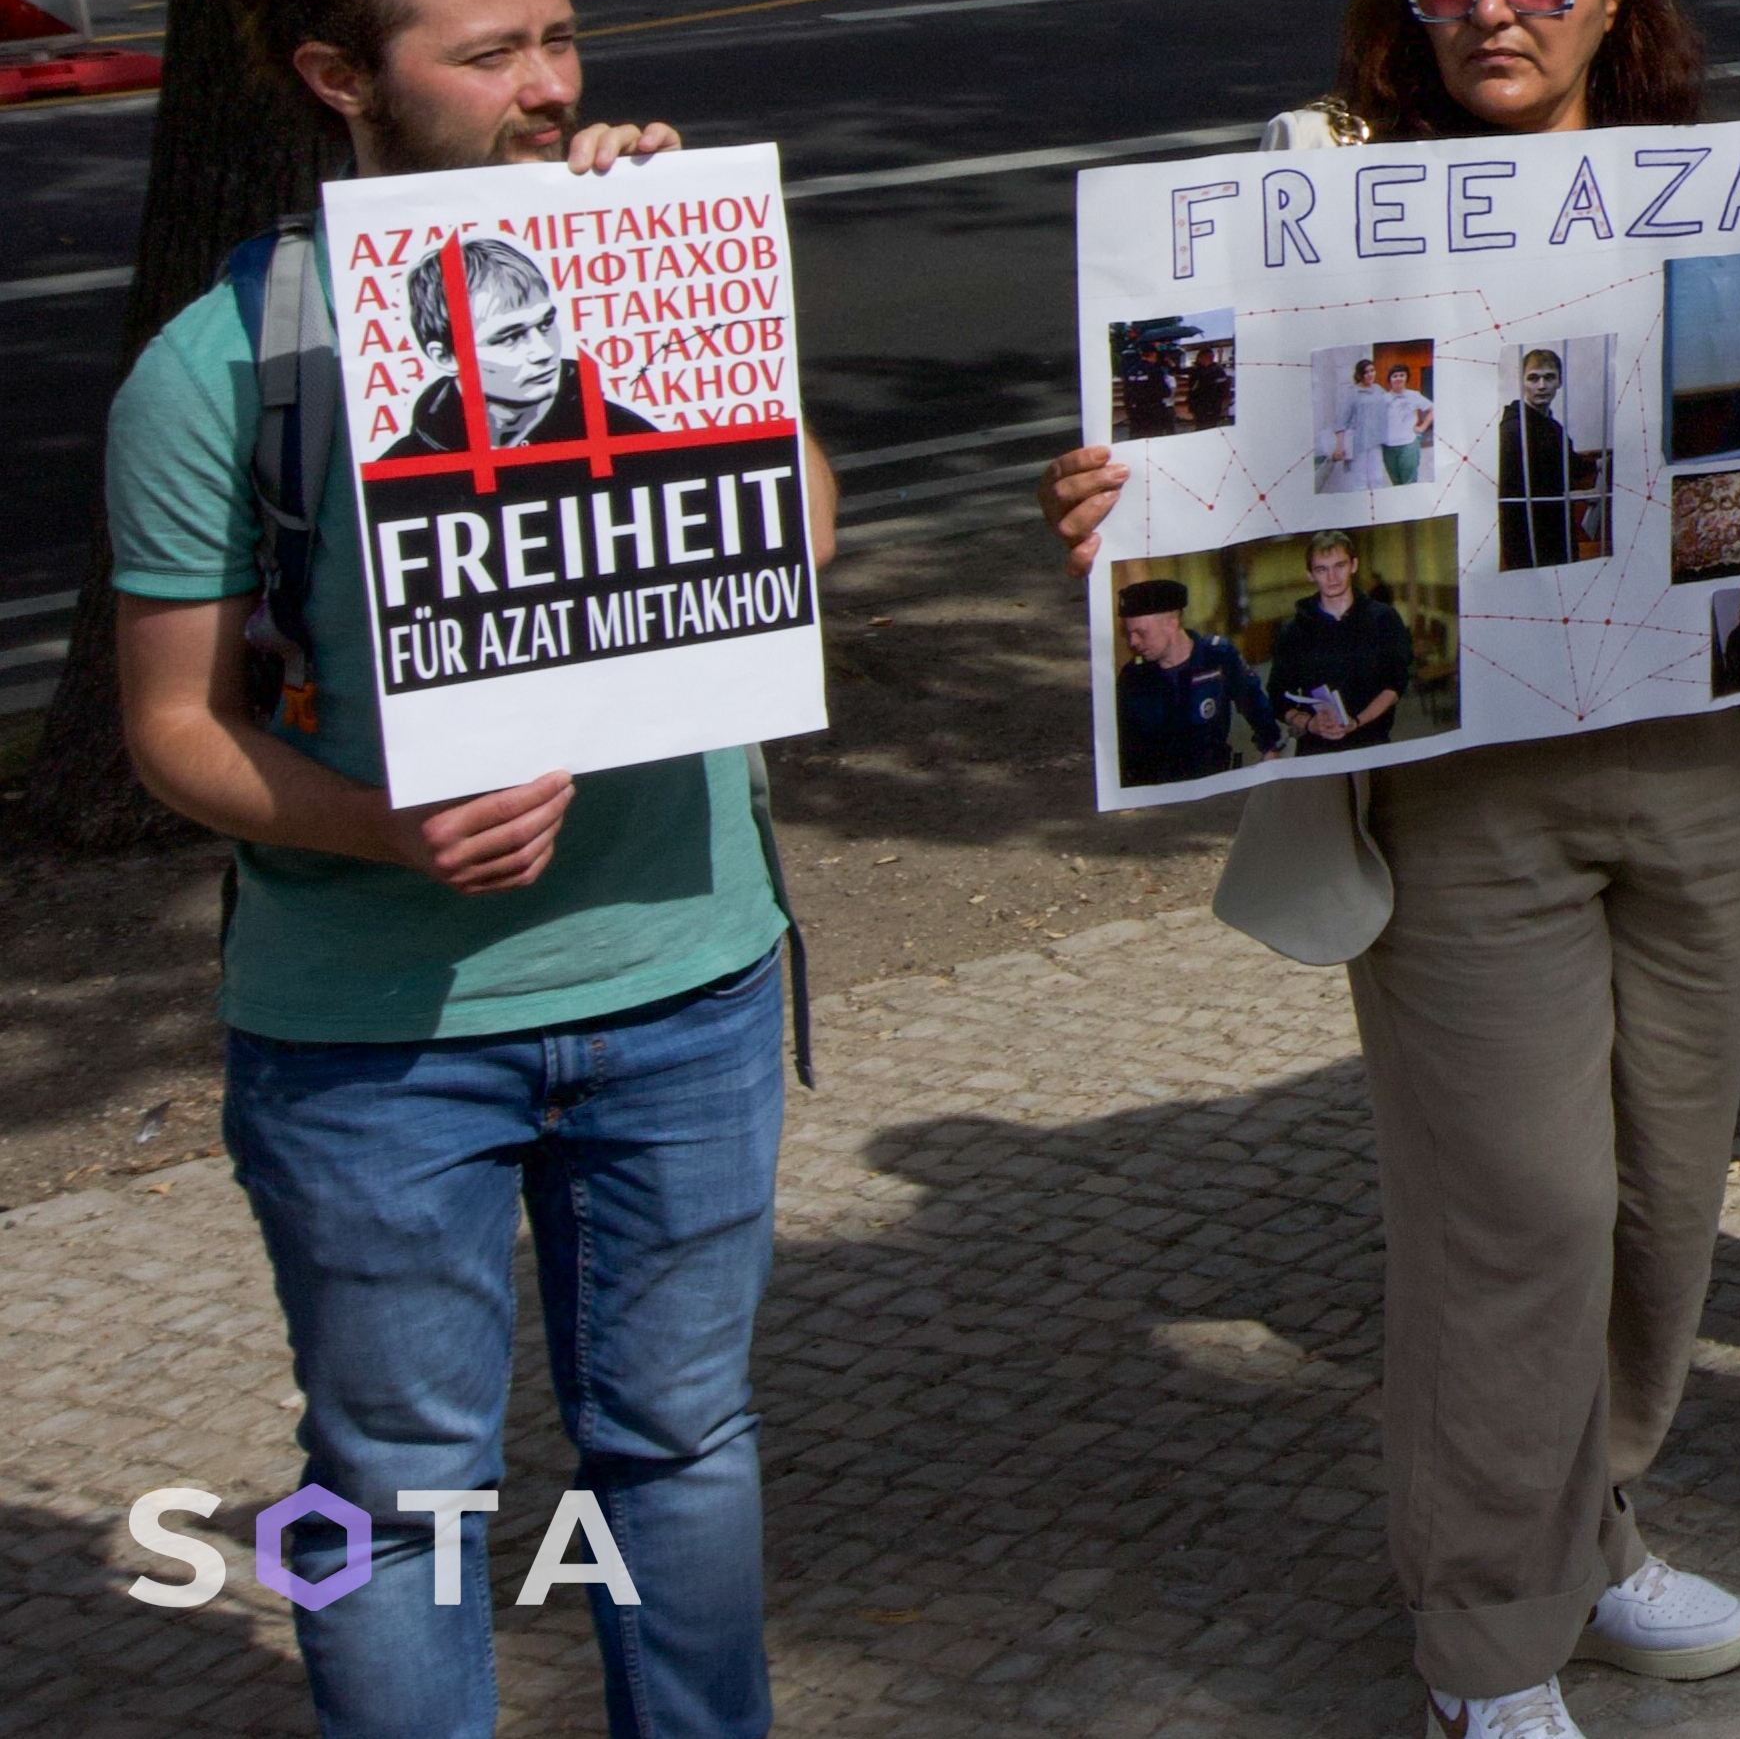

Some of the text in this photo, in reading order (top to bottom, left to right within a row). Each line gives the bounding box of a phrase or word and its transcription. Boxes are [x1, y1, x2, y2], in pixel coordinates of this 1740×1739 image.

[549, 234, 779, 291] ИФТАХОВ
[1171, 160, 1517, 280] FREE
[571, 274, 780, 332] FTAKHOV
[376, 466, 793, 608] FREIHEIT
[388, 564, 803, 686] FÜR AZAT MIFTAKHOV
